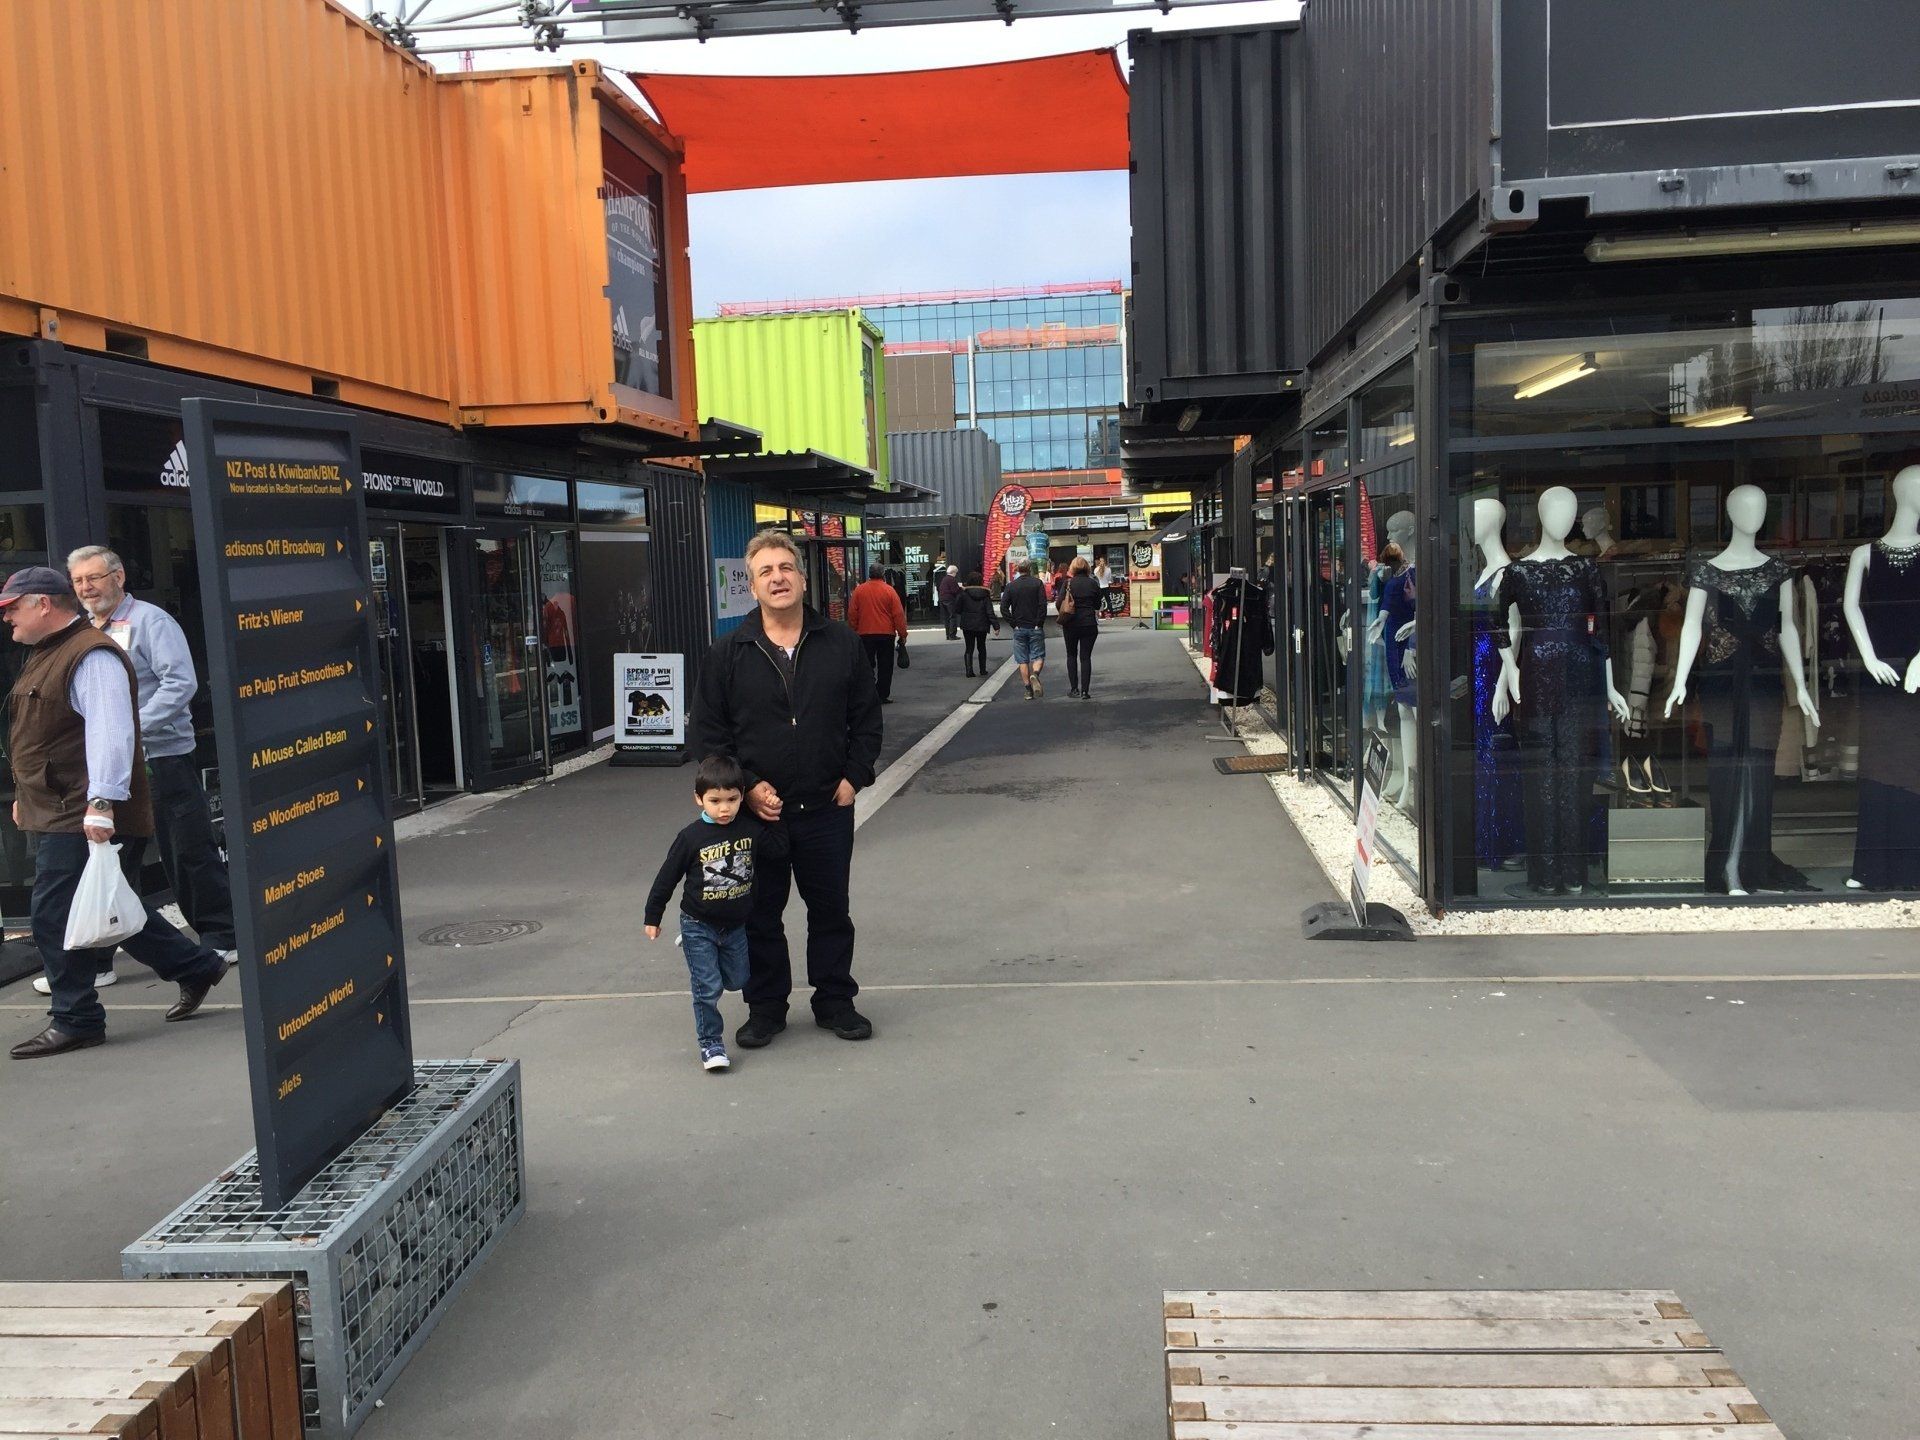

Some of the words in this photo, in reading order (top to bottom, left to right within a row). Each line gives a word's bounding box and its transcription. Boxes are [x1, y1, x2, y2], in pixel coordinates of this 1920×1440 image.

[226, 461, 242, 478] NZ
[244, 462, 268, 479] Post
[269, 463, 277, 479] &
[245, 483, 269, 494] located
[269, 484, 275, 493] in
[300, 484, 314, 494] Food
[314, 485, 329, 494] Court
[392, 475, 400, 486] OF
[401, 476, 412, 487] THE
[412, 478, 444, 497] WORLD
[225, 540, 265, 557] adisons
[265, 539, 281, 555] Off
[281, 540, 326, 557] Broadway
[866, 534, 882, 542] INF
[866, 541, 891, 551] INITE
[904, 546, 922, 555] DEF
[905, 554, 930, 564] INITE
[238, 612, 270, 631] Fritz's
[270, 609, 304, 626] Wiener
[254, 678, 277, 695] Pulp
[277, 671, 300, 690] Fruit
[300, 662, 345, 685] Smoothies
[560, 710, 578, 727] $35
[251, 752, 261, 770] A
[261, 746, 295, 766] Mouse
[295, 733, 324, 755] Called
[325, 729, 347, 746] Bean
[268, 796, 317, 827] Woodfired
[316, 790, 340, 809] Pizza
[700, 843, 731, 862] SKATE
[733, 837, 753, 851] CITY
[264, 879, 296, 905] Maher
[296, 865, 325, 889] Shoes
[702, 889, 728, 901] BOARD
[289, 930, 310, 952] New
[310, 908, 345, 940] Zealand
[278, 995, 329, 1041] Untouched
[328, 978, 354, 1007] World
